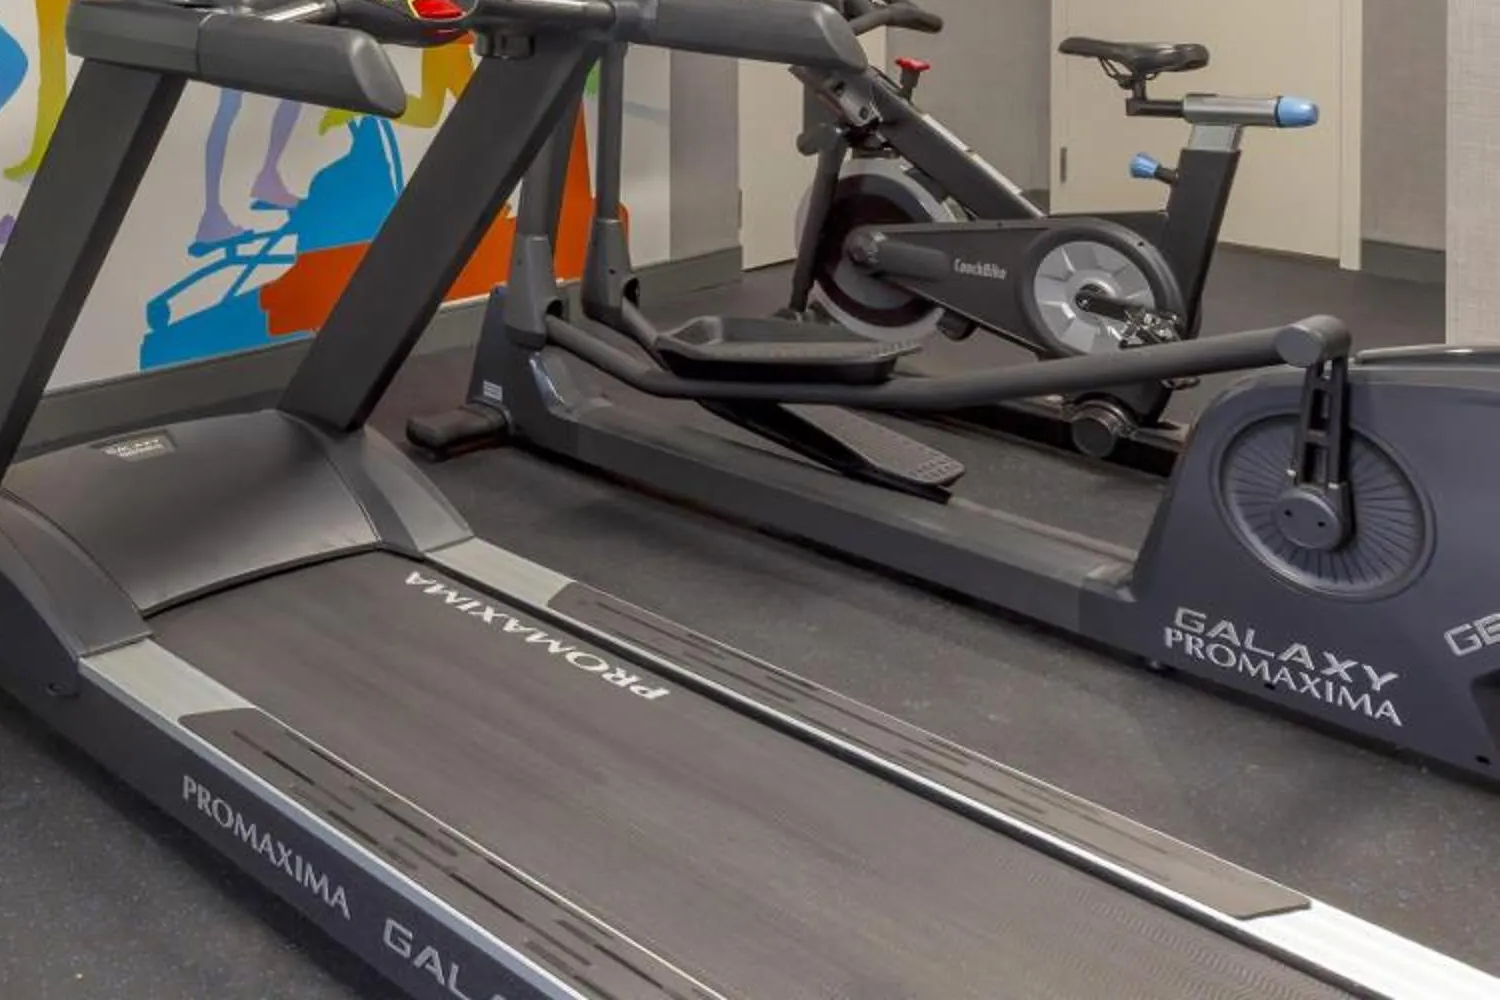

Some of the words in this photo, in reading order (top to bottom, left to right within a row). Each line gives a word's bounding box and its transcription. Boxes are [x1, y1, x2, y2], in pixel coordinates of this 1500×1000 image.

[405, 571, 670, 699] PROMAXIMA
[1164, 626, 1402, 727] PROMAXIMA
[1174, 606, 1399, 692] GALAXY
[182, 774, 351, 920] PROMAXIMA
[382, 917, 506, 1000] GAL
